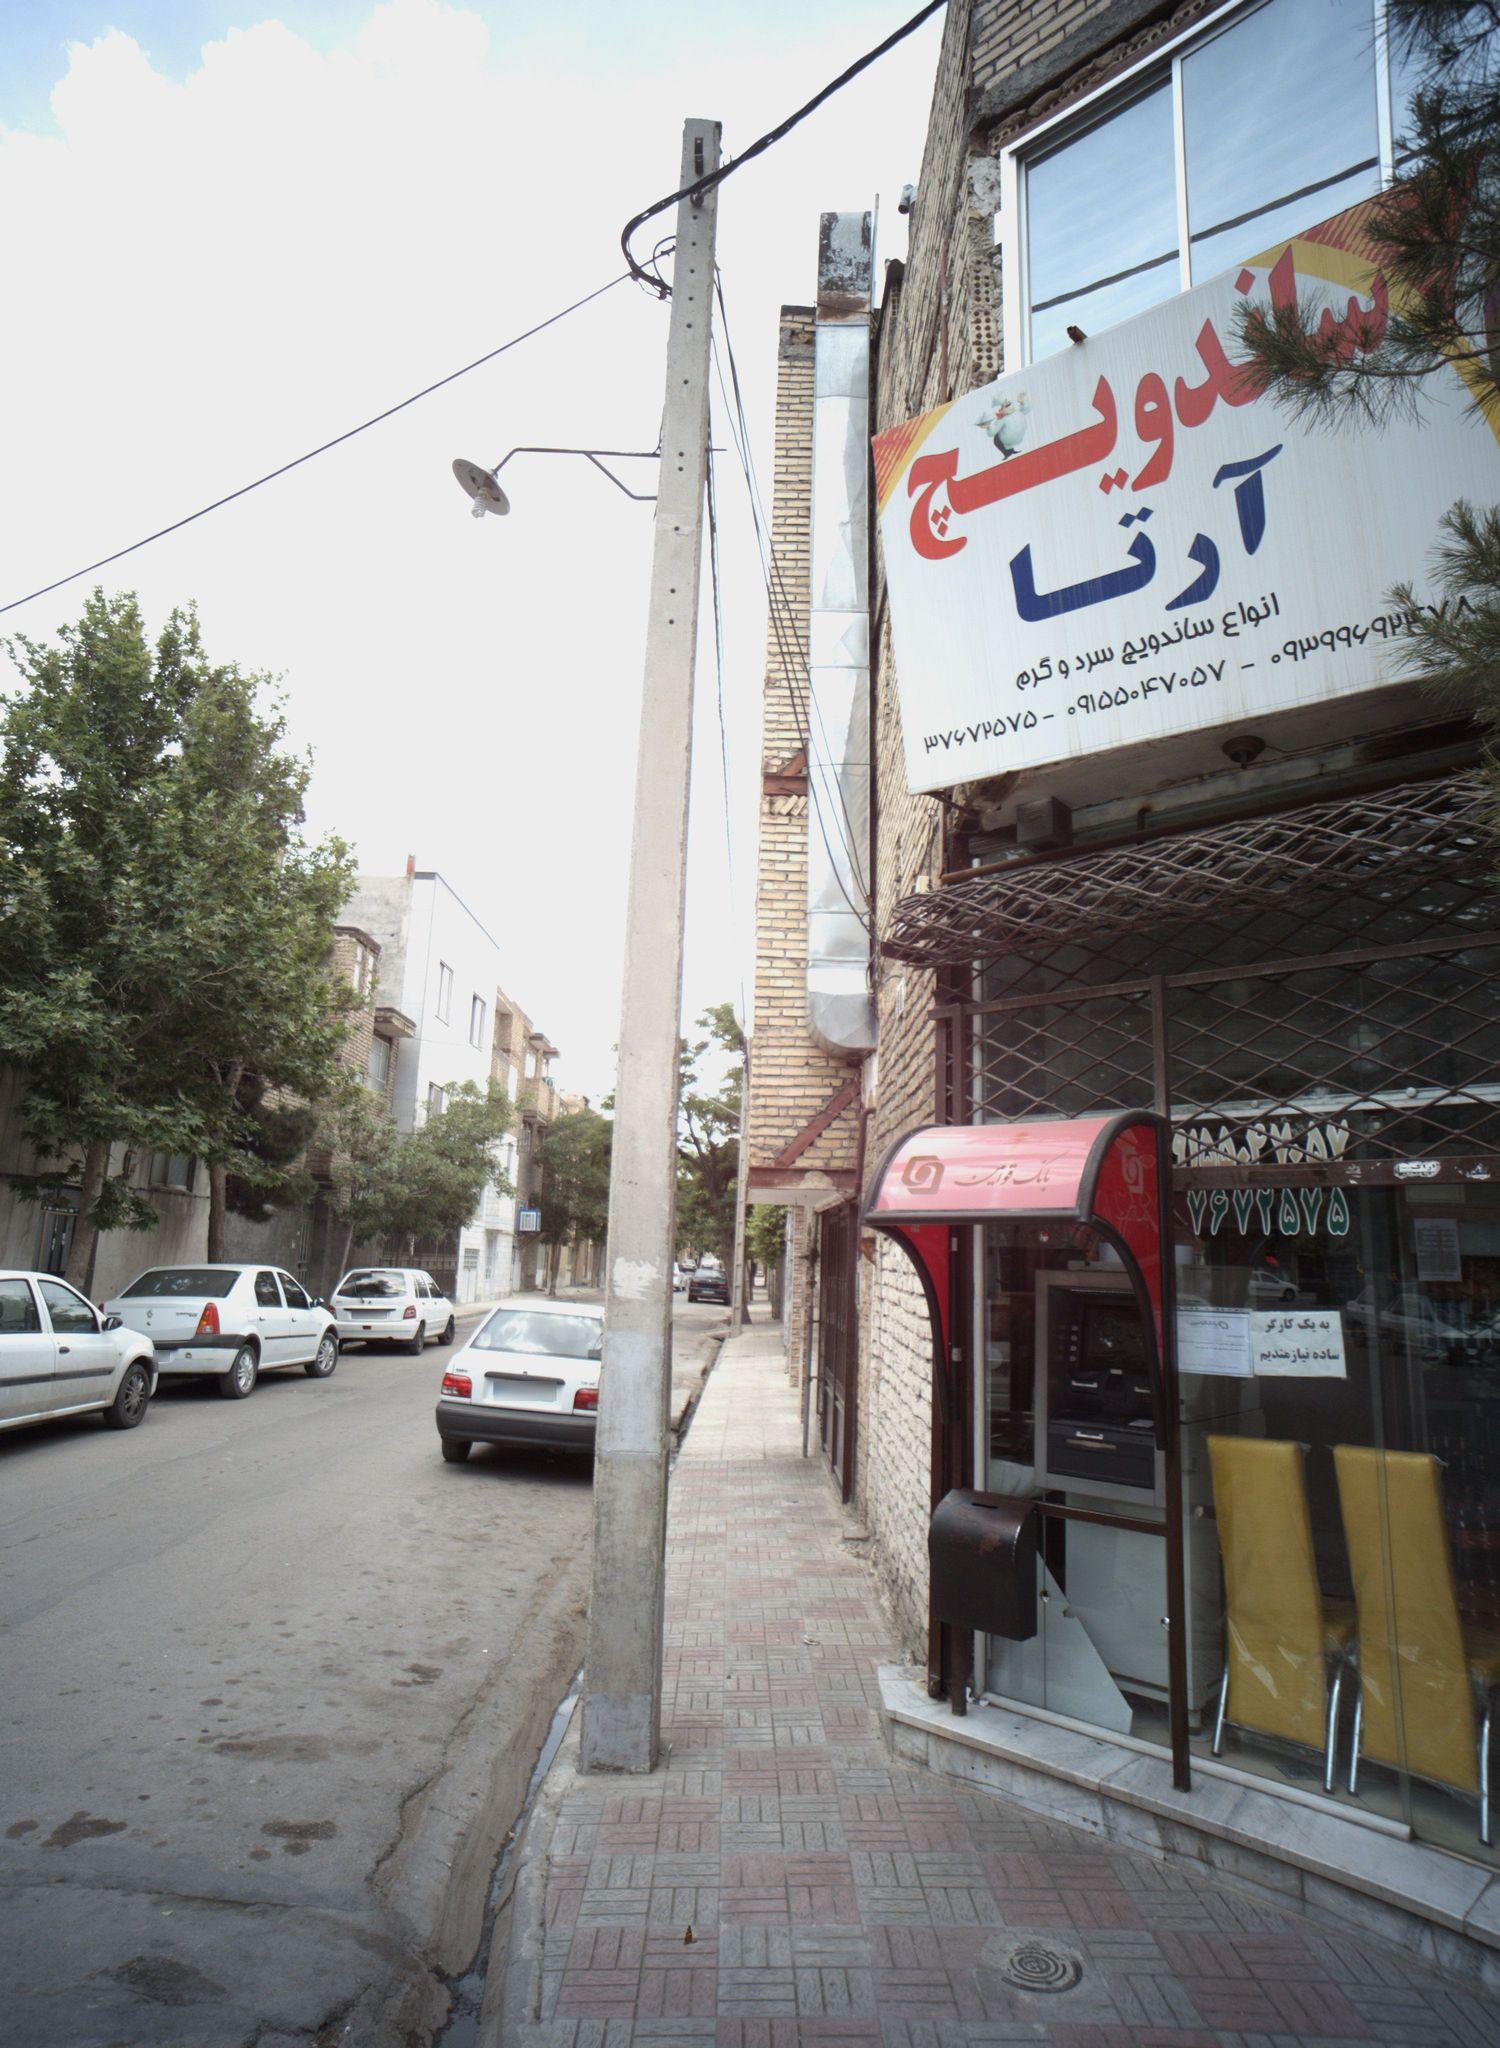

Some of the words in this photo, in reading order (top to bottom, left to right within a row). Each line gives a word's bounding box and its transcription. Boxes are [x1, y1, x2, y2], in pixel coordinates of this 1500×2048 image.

[1009, 443, 1283, 622] آرتا
[1222, 592, 1281, 638] انواع
[1122, 617, 1215, 666] ساندویچ
[1015, 655, 1053, 691] گرم
[1058, 661, 1070, 679] و
[1075, 648, 1114, 674] سرد
[1067, 659, 1227, 717] ۰۹۱۵۵۰۴۷۰۵۷
[923, 710, 1038, 754] ۳۷۶۷۲۵۷۵
[954, 1163, 1018, 1187] قوامین
[1013, 1152, 1067, 1192] بانک
[1264, 1318, 1295, 1334] کارگر
[1297, 1318, 1317, 1333] یک
[1318, 1320, 1331, 1334] به
[1312, 1349, 1340, 1361] ساده
